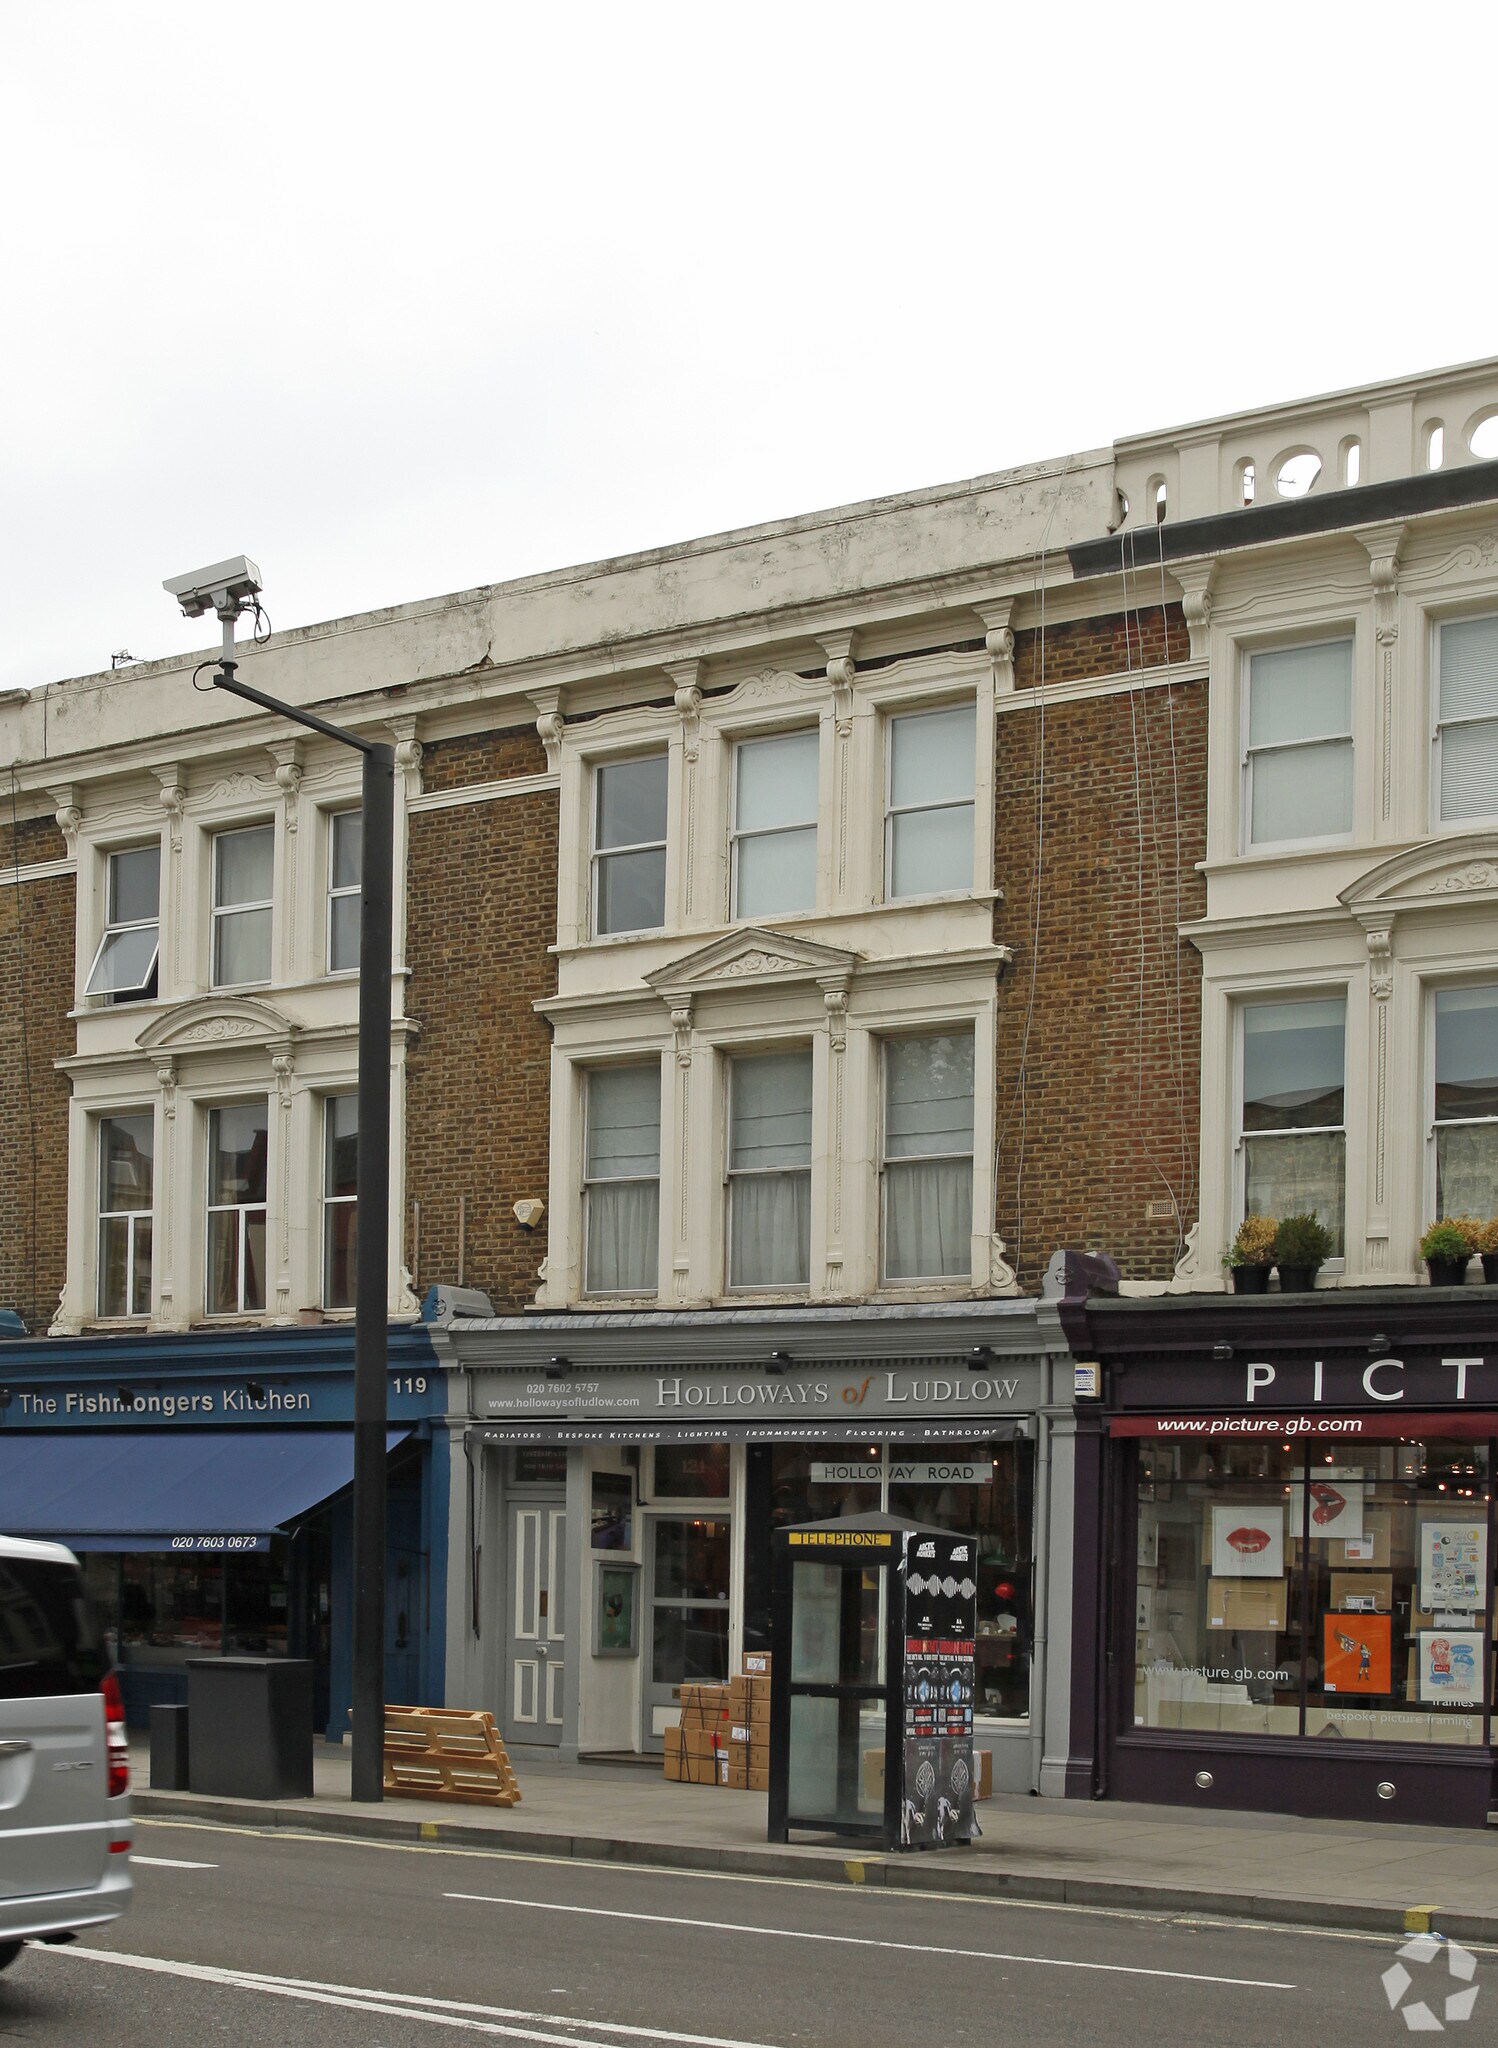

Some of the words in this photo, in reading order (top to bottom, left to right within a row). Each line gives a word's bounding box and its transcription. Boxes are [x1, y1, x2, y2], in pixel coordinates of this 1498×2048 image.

[393, 1377, 427, 1394] 119
[526, 1384, 545, 1394] 020
[548, 1383, 571, 1393] 7602
[575, 1383, 600, 1393] 5757
[841, 1375, 875, 1408] of
[19, 1394, 57, 1413] The
[223, 1389, 310, 1411] Kitchen
[488, 1397, 640, 1410] www.hollowaysofludlow.com
[1157, 1417, 1363, 1435] www.picture.gb.com
[557, 1431, 603, 1439] BESPOKE
[609, 1431, 661, 1439] KITCHENS
[677, 1430, 728, 1438] LIGHTING
[825, 1466, 916, 1479] HOLLOWAY
[928, 1467, 974, 1480] ROAD
[171, 1536, 194, 1548] 020
[197, 1536, 225, 1548] 7603
[227, 1536, 257, 1548] 0673
[798, 1533, 882, 1546] TELEPHONE
[1143, 1665, 1289, 1681] wwwpicture.gb.com
[1326, 1710, 1376, 1723] bespoke
[1380, 1712, 1423, 1725] picture
[1427, 1714, 1473, 1729] framing
